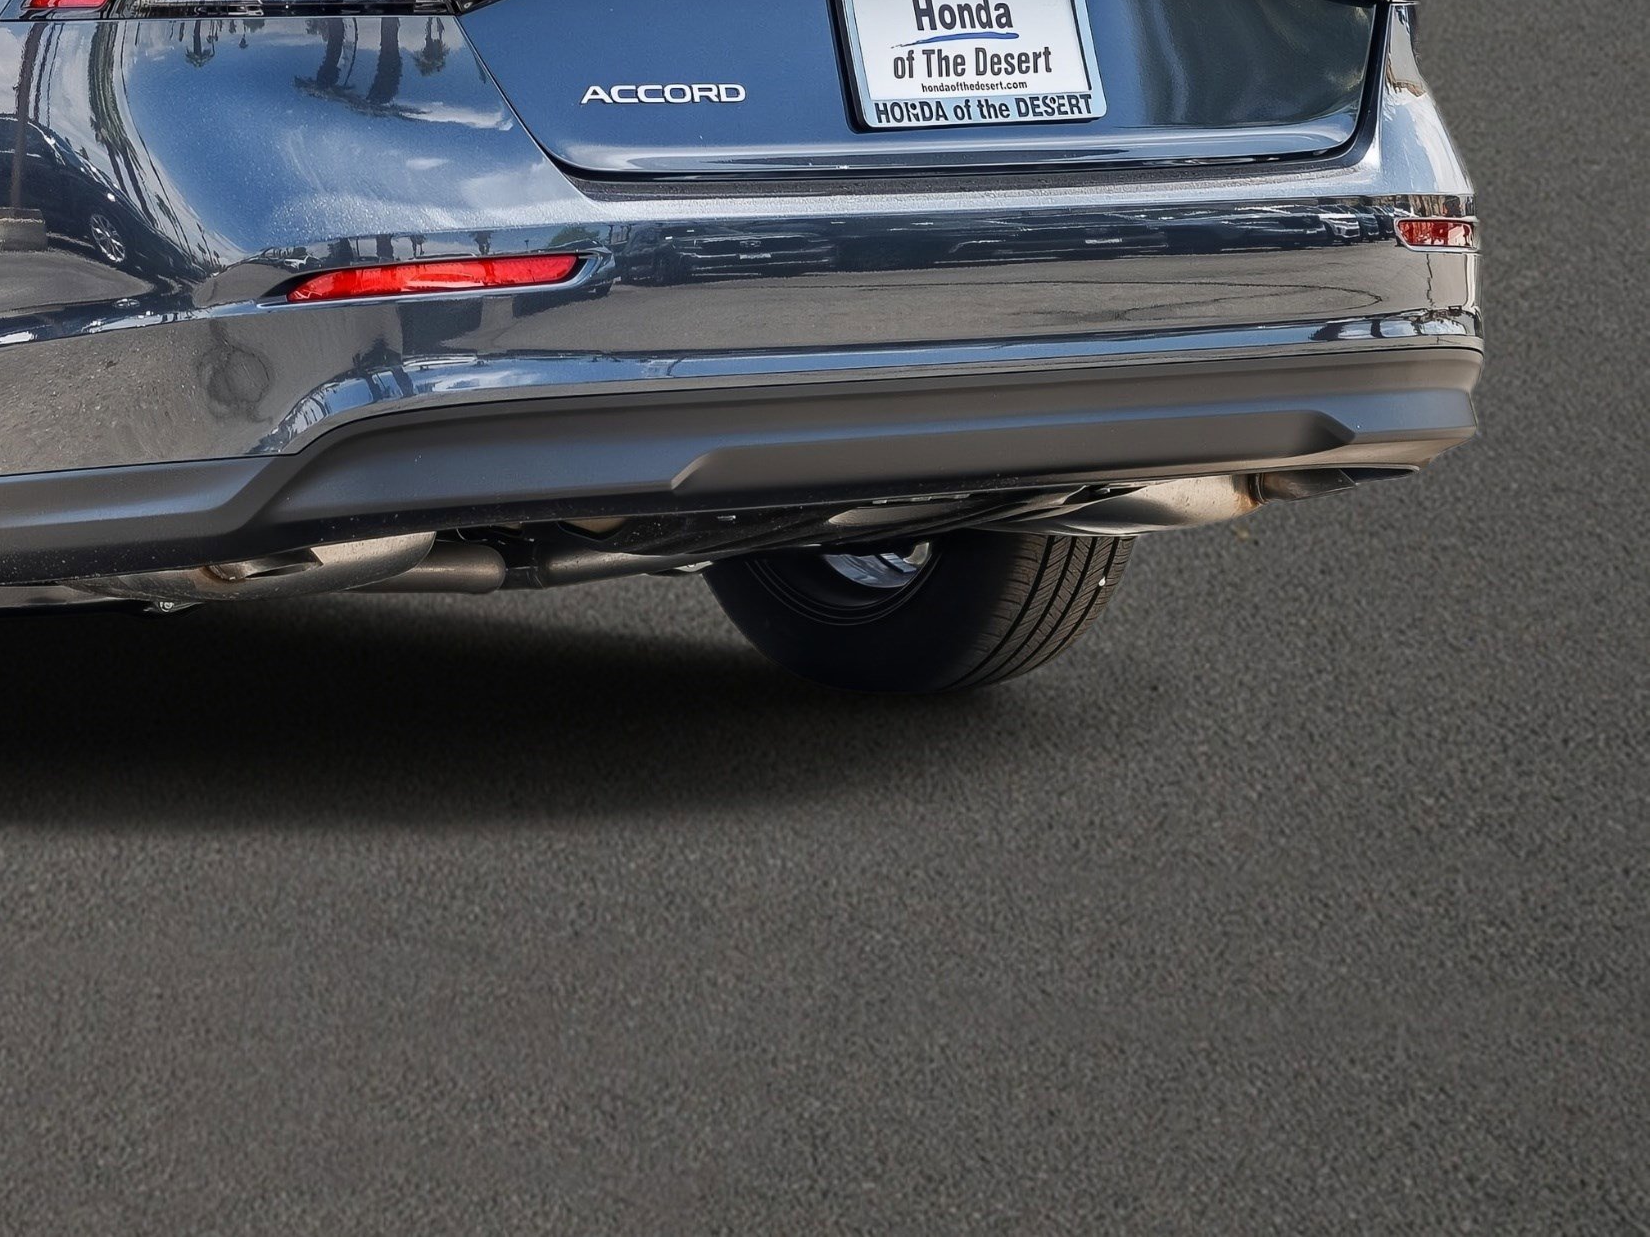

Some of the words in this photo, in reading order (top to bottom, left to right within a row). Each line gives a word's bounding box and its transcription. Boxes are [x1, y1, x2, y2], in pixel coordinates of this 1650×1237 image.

[893, 49, 915, 80] of
[922, 48, 966, 78] The
[974, 46, 1052, 76] Desert
[580, 83, 746, 104] ACCORD
[921, 79, 1028, 93] hondaofthedesert.com
[874, 100, 949, 124] HONDA
[953, 101, 974, 121] of
[977, 99, 1011, 119] the
[1014, 93, 1092, 118] DESERT
